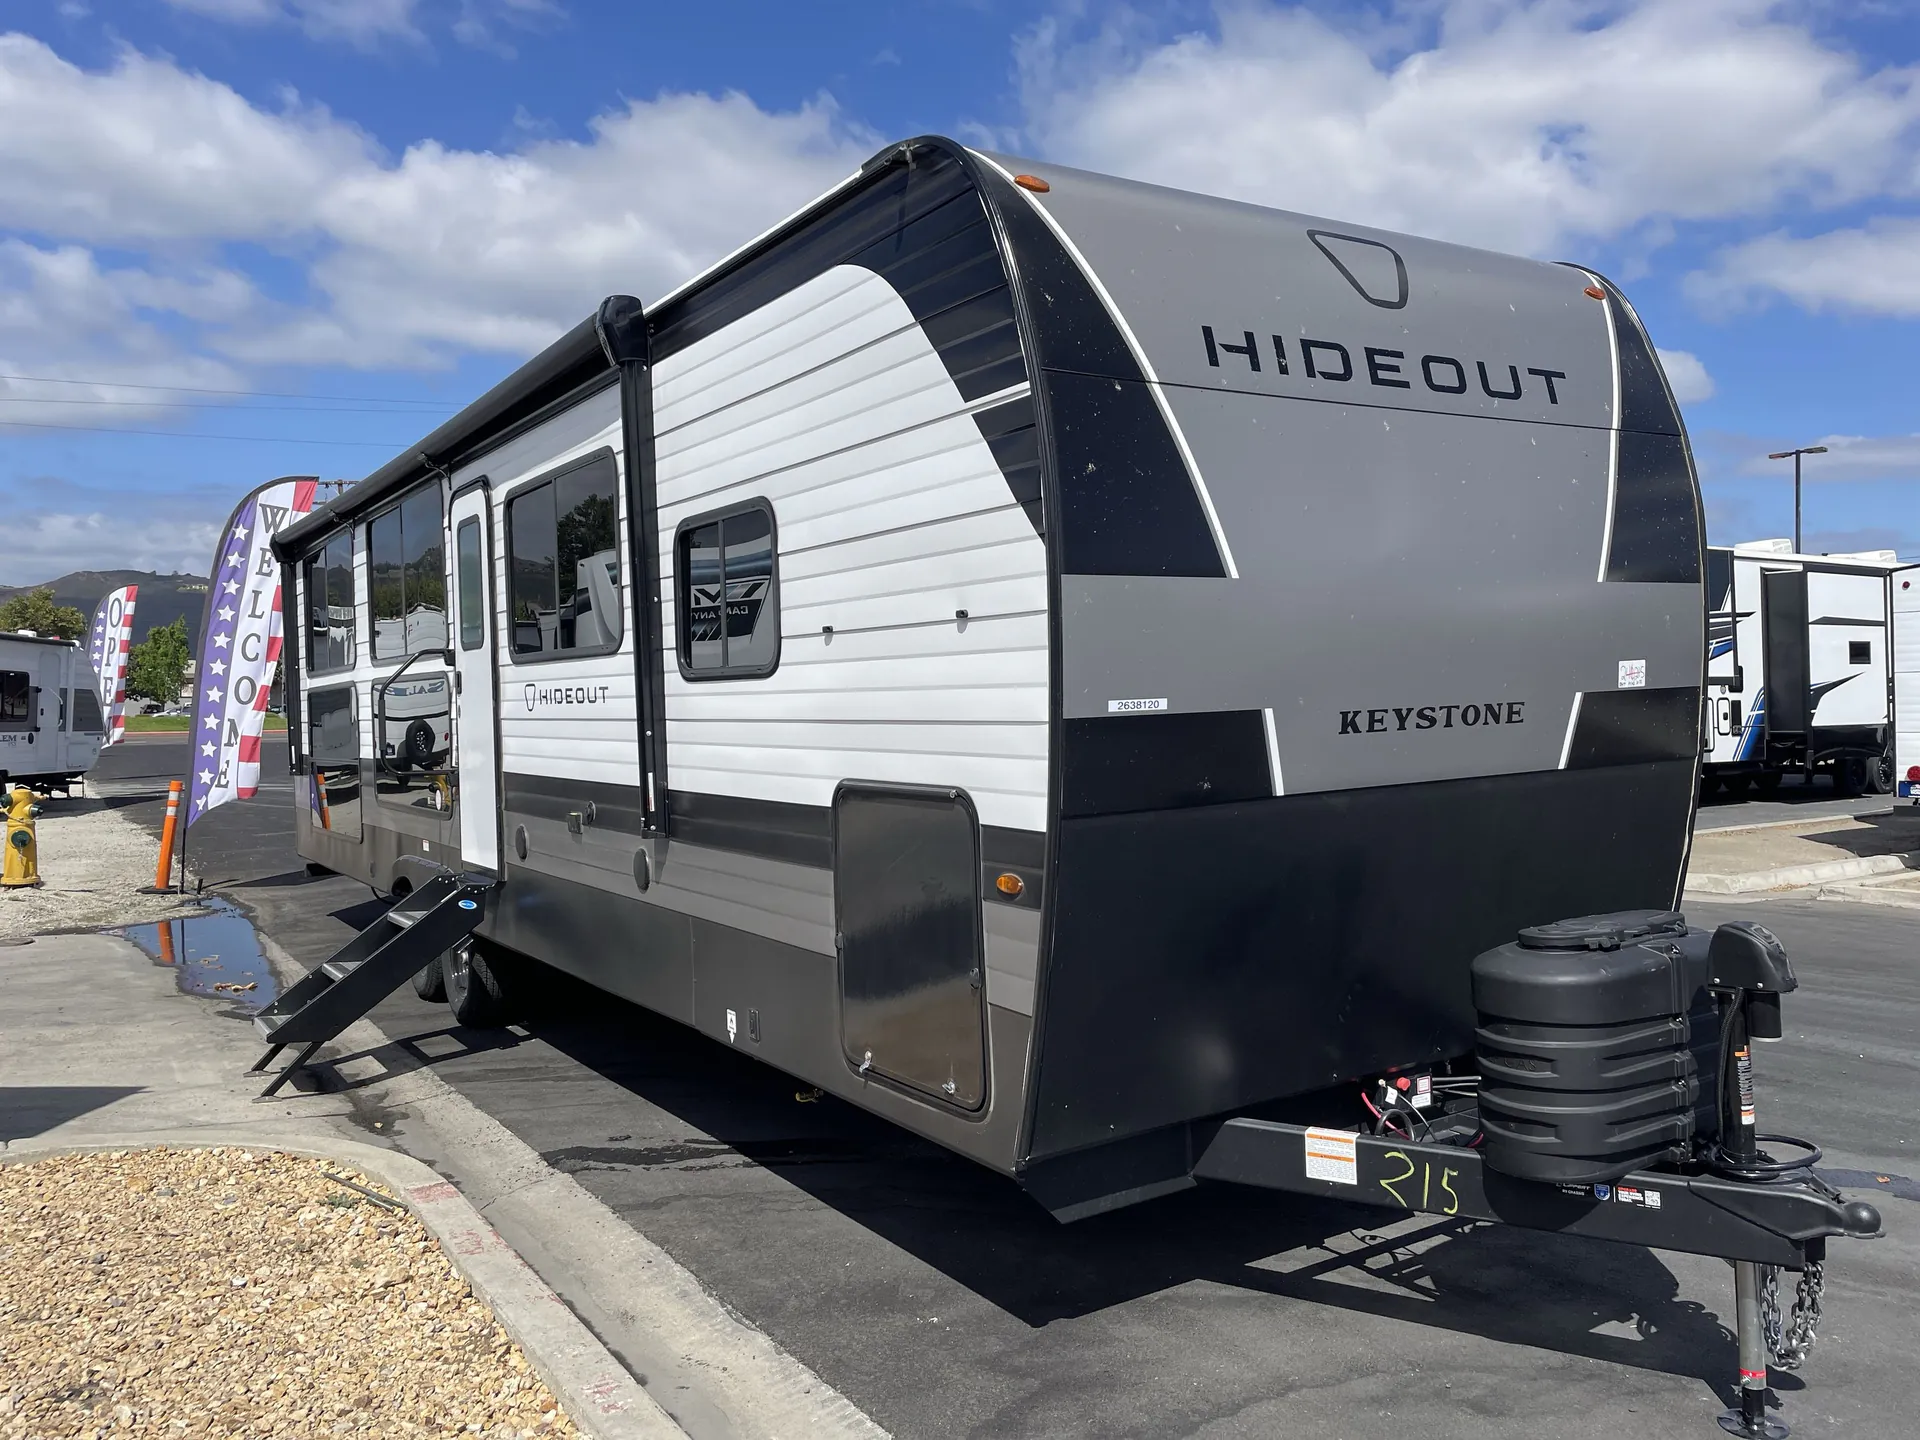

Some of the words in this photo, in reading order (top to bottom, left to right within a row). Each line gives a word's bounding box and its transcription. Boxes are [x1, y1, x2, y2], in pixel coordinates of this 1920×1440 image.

[1201, 325, 1566, 405] HIDEOUT
[539, 686, 609, 705] HIDEOUT
[1117, 699, 1160, 711] 2638120
[1338, 701, 1526, 735] KEYSTONE
[1379, 1151, 1459, 1214] 215
